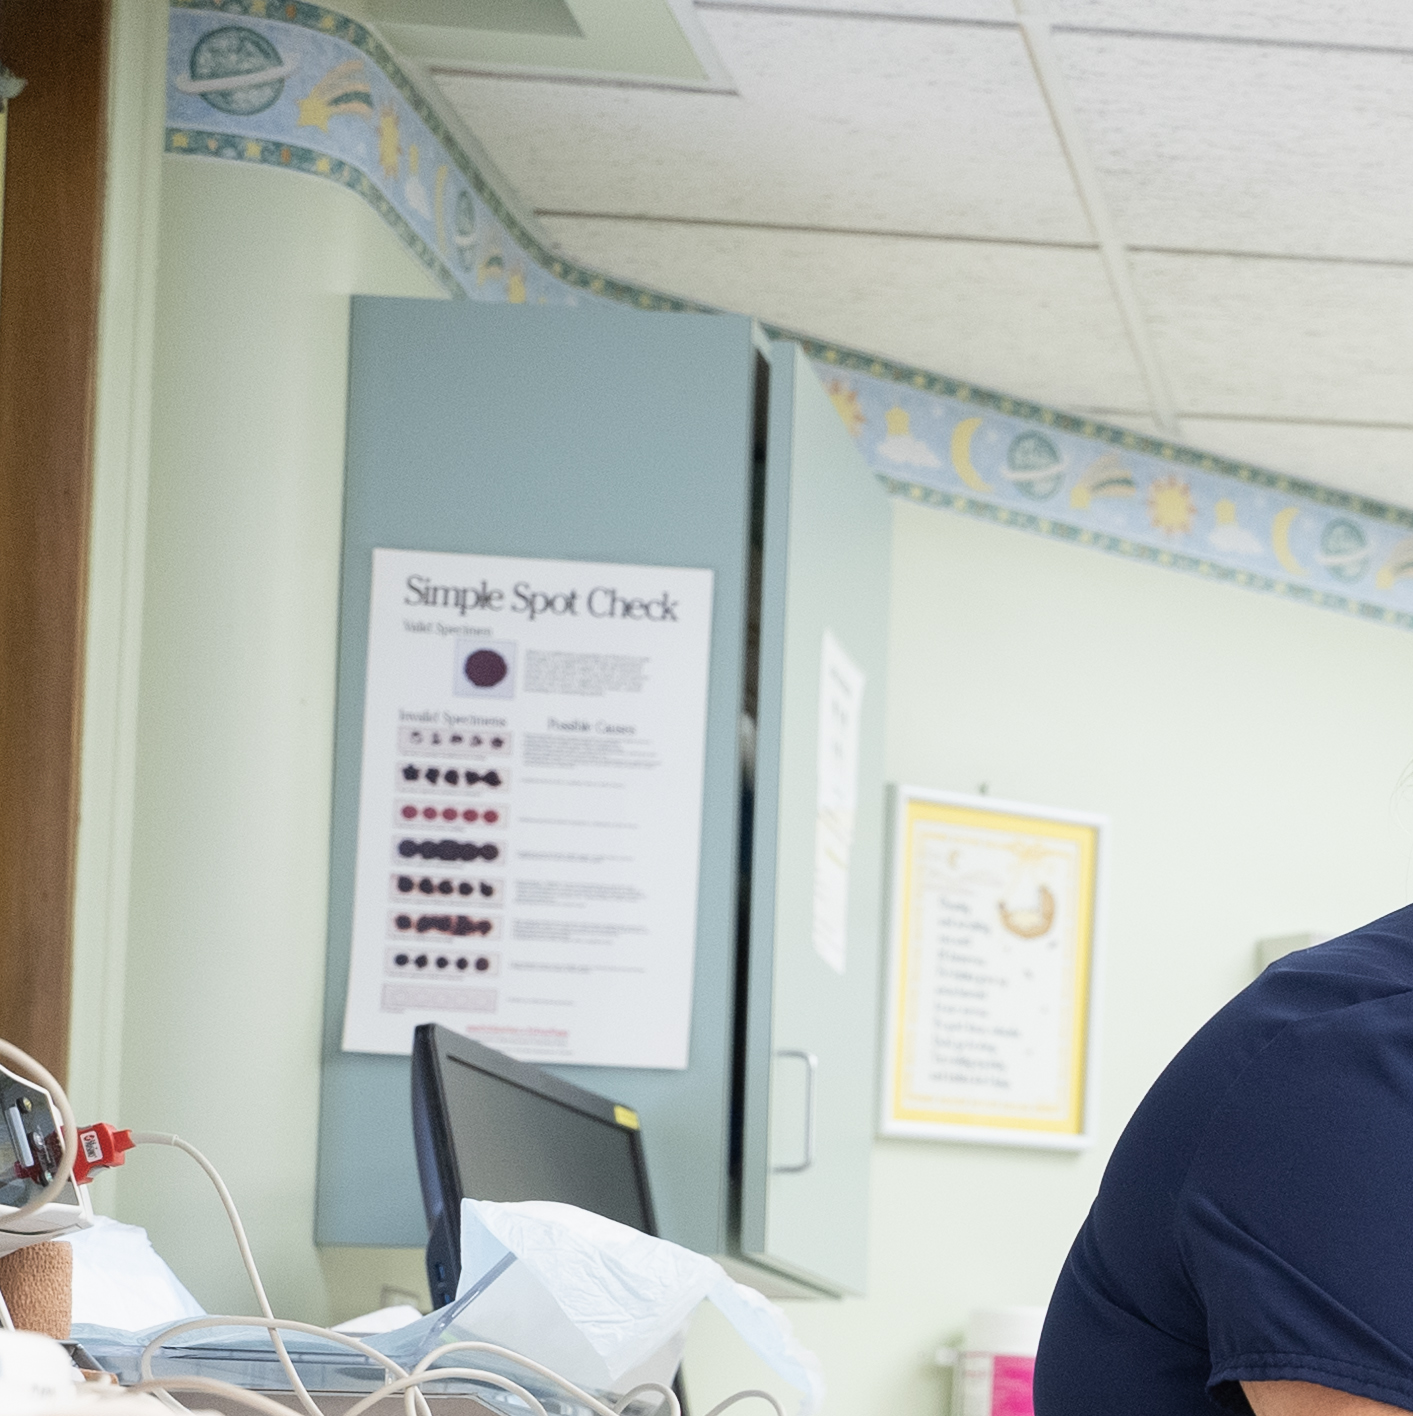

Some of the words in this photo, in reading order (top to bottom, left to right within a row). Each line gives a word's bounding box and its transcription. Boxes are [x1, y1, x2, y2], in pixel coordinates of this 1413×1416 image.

[404, 574, 504, 616] Simple
[510, 581, 579, 620] Spot
[586, 585, 679, 622] Check
